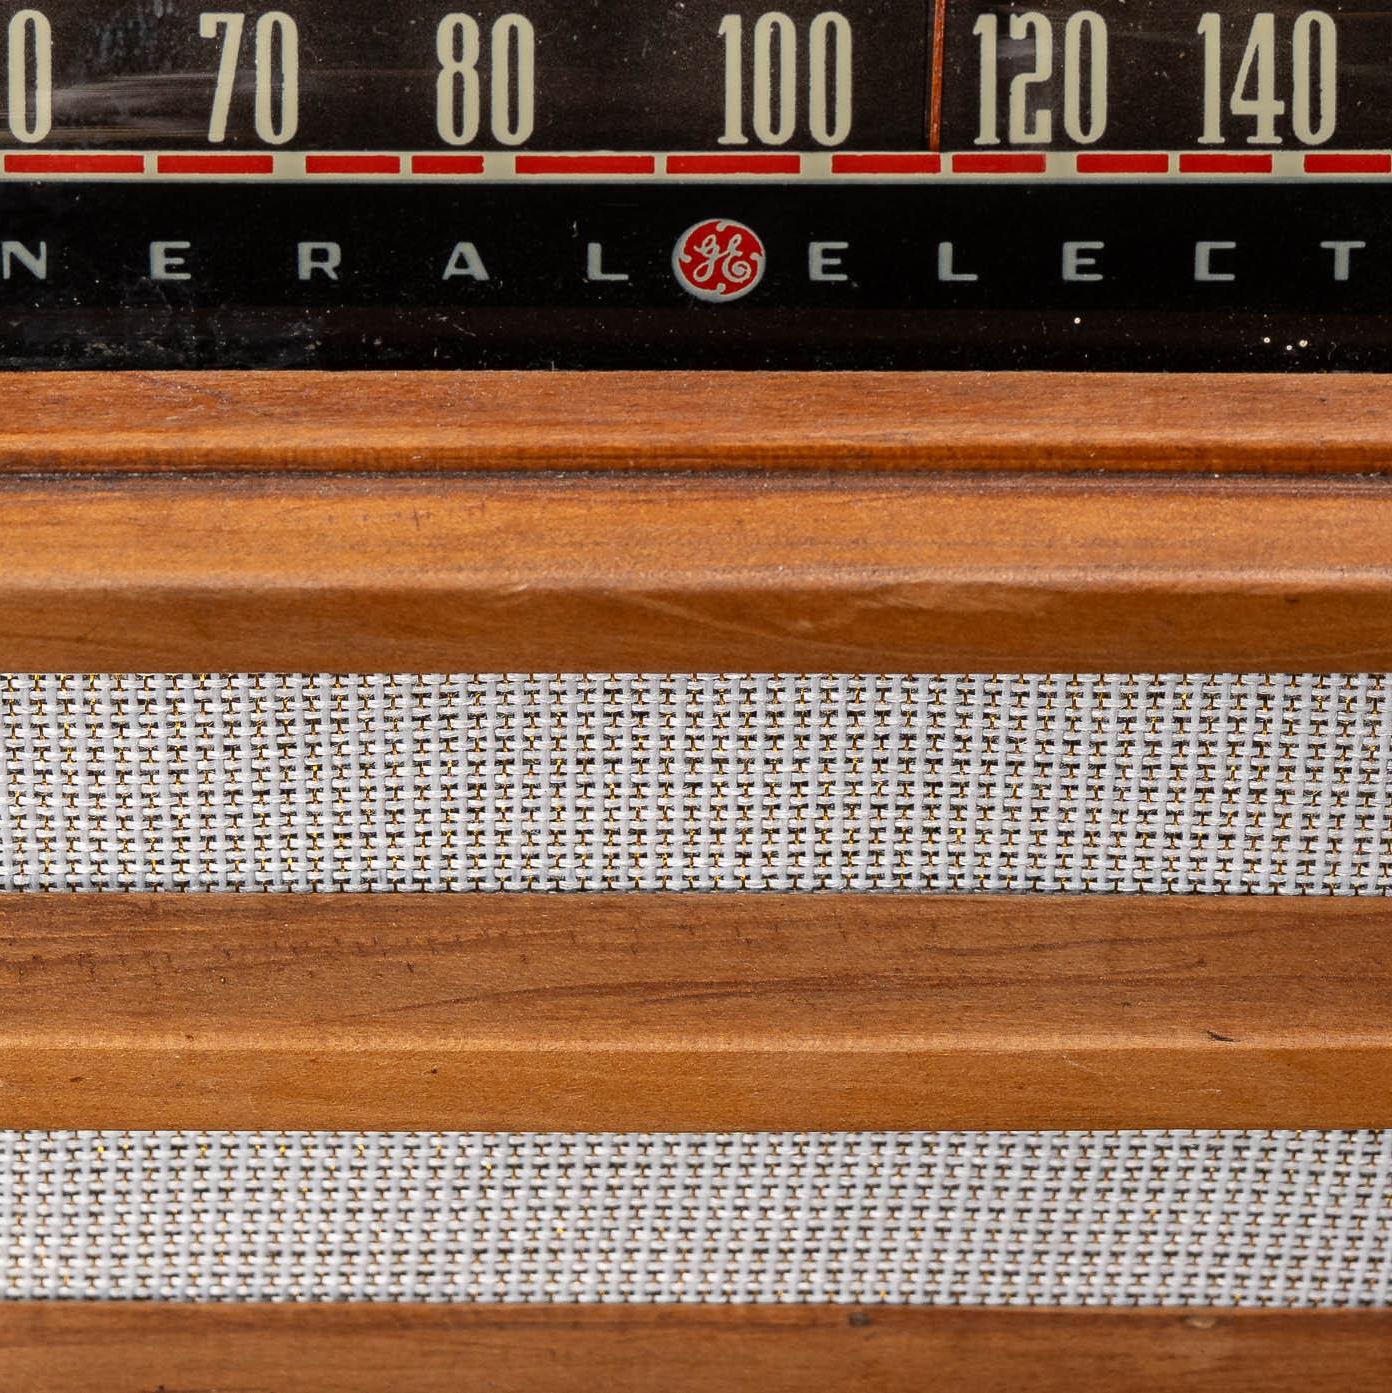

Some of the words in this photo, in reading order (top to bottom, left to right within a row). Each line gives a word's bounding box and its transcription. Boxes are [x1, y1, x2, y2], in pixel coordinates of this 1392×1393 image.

[198, 10, 299, 145] 70
[435, 11, 536, 146] 80
[716, 11, 853, 146] 100
[971, 10, 1108, 146] 120
[1195, 10, 1338, 146] 140
